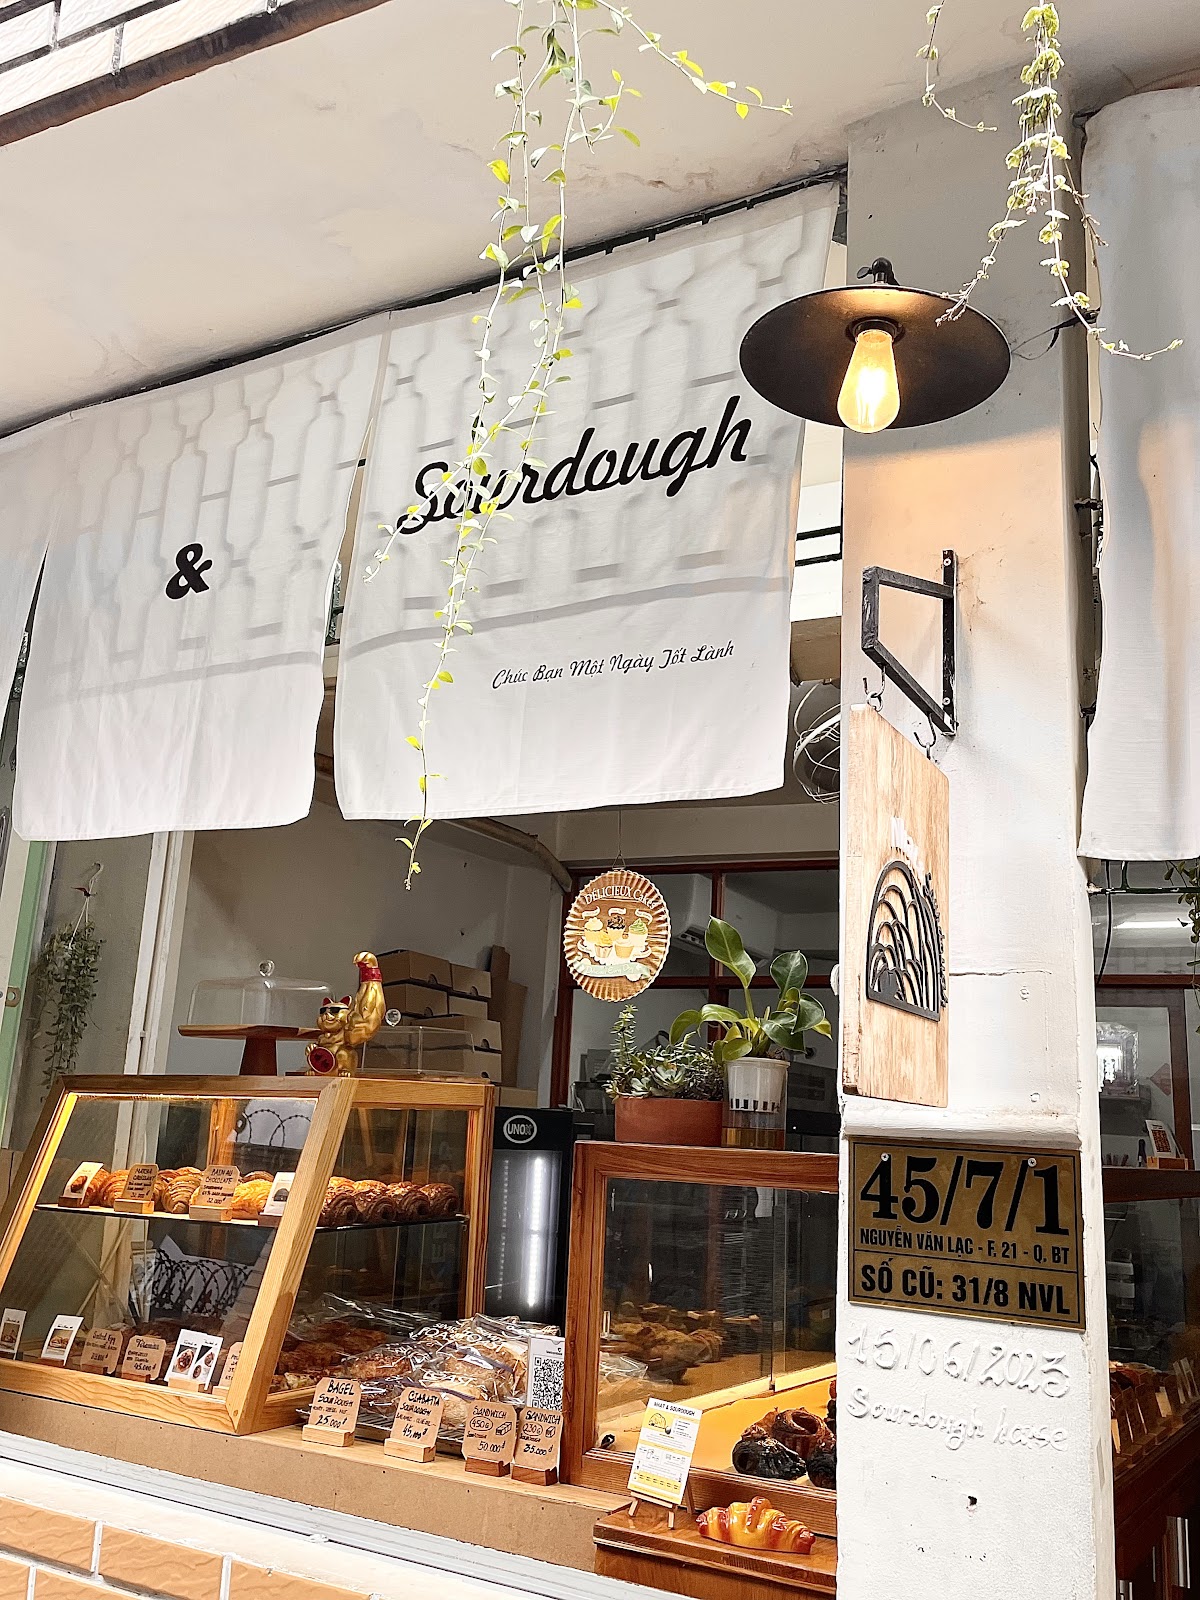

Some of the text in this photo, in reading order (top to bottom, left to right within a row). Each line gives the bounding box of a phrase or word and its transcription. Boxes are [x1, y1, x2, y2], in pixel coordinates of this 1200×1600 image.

[396, 395, 752, 535] Sourdough
[165, 543, 213, 600] &
[492, 640, 735, 690] Chúc Bạn Một Ngày Tốt Lành
[584, 885, 657, 909] DÉLICIEUX Cakes
[507, 1123, 533, 1136] UNOX
[860, 1153, 1070, 1236] 45/7/1
[860, 1225, 913, 1249] NGUYỄN
[916, 1230, 944, 1252] VĂN
[947, 1236, 974, 1258] LẠC
[1001, 1241, 1017, 1259] 21
[1051, 1246, 1070, 1265] BT
[861, 1257, 1071, 1316] SỐ CŨ: 31/8 NVL
[847, 1323, 1070, 1399] 15/06/2023
[327, 1379, 354, 1396] BAGEL
[473, 1405, 507, 1419] SANDWICH
[525, 1410, 561, 1425] SANDWICH
[669, 1405, 696, 1416] SOURDOUGH
